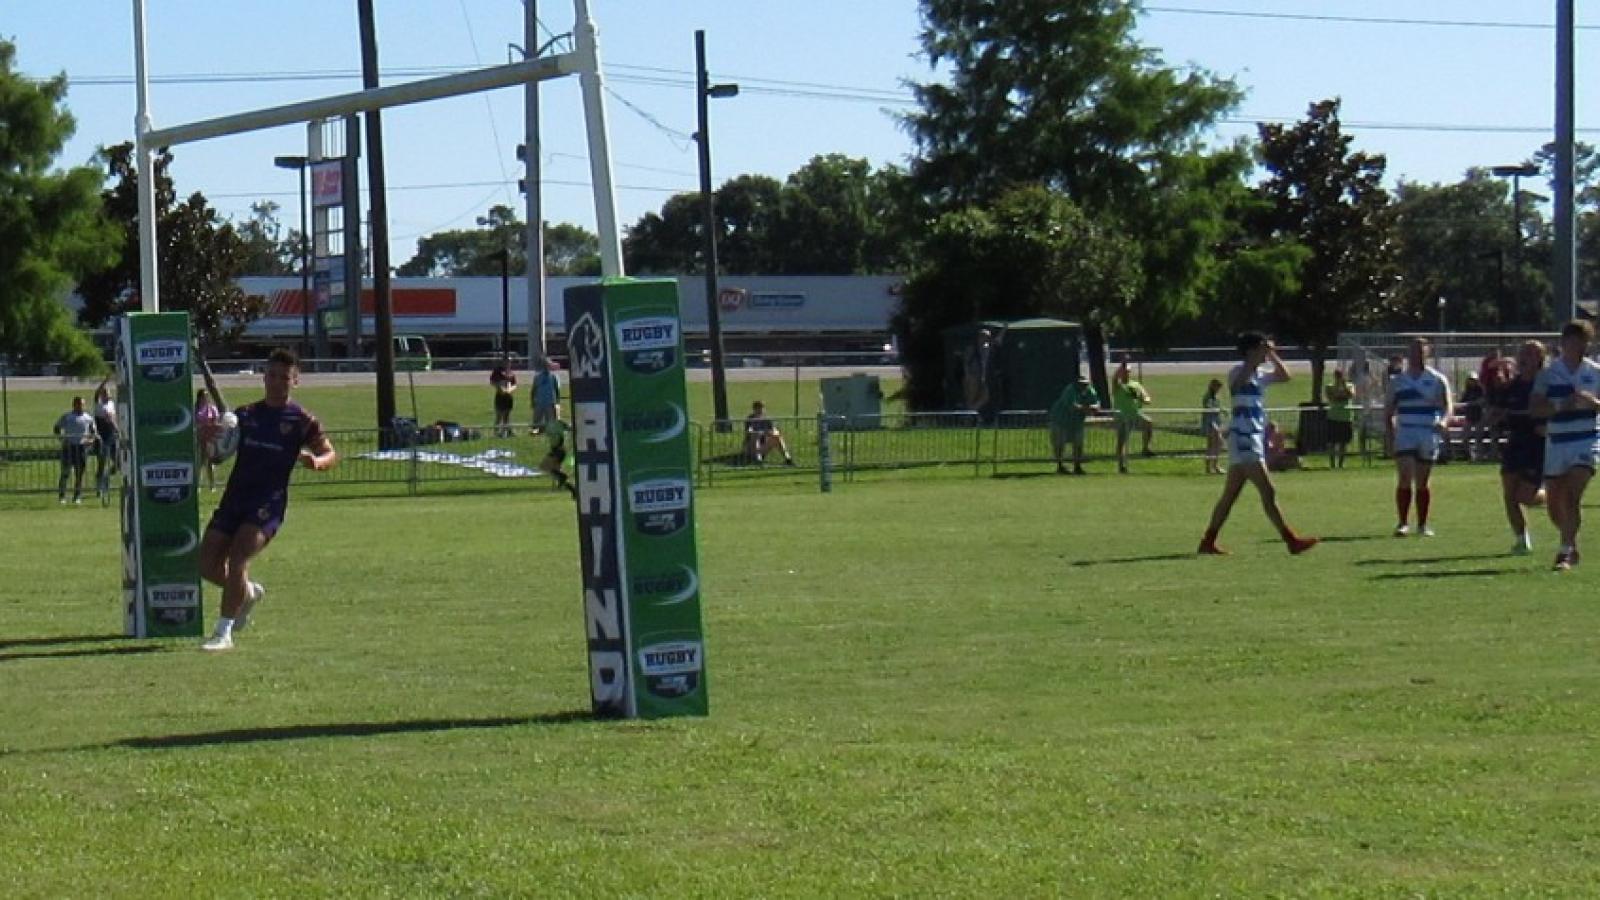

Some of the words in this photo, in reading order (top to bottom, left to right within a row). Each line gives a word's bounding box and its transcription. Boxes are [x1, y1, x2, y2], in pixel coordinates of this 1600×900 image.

[621, 324, 673, 343] RUGBY
[140, 346, 183, 359] RUGBY
[146, 468, 188, 480] RUGBY
[634, 486, 685, 504] RUGBY
[152, 590, 195, 601] RUGBY
[644, 649, 696, 666] RUGBY
